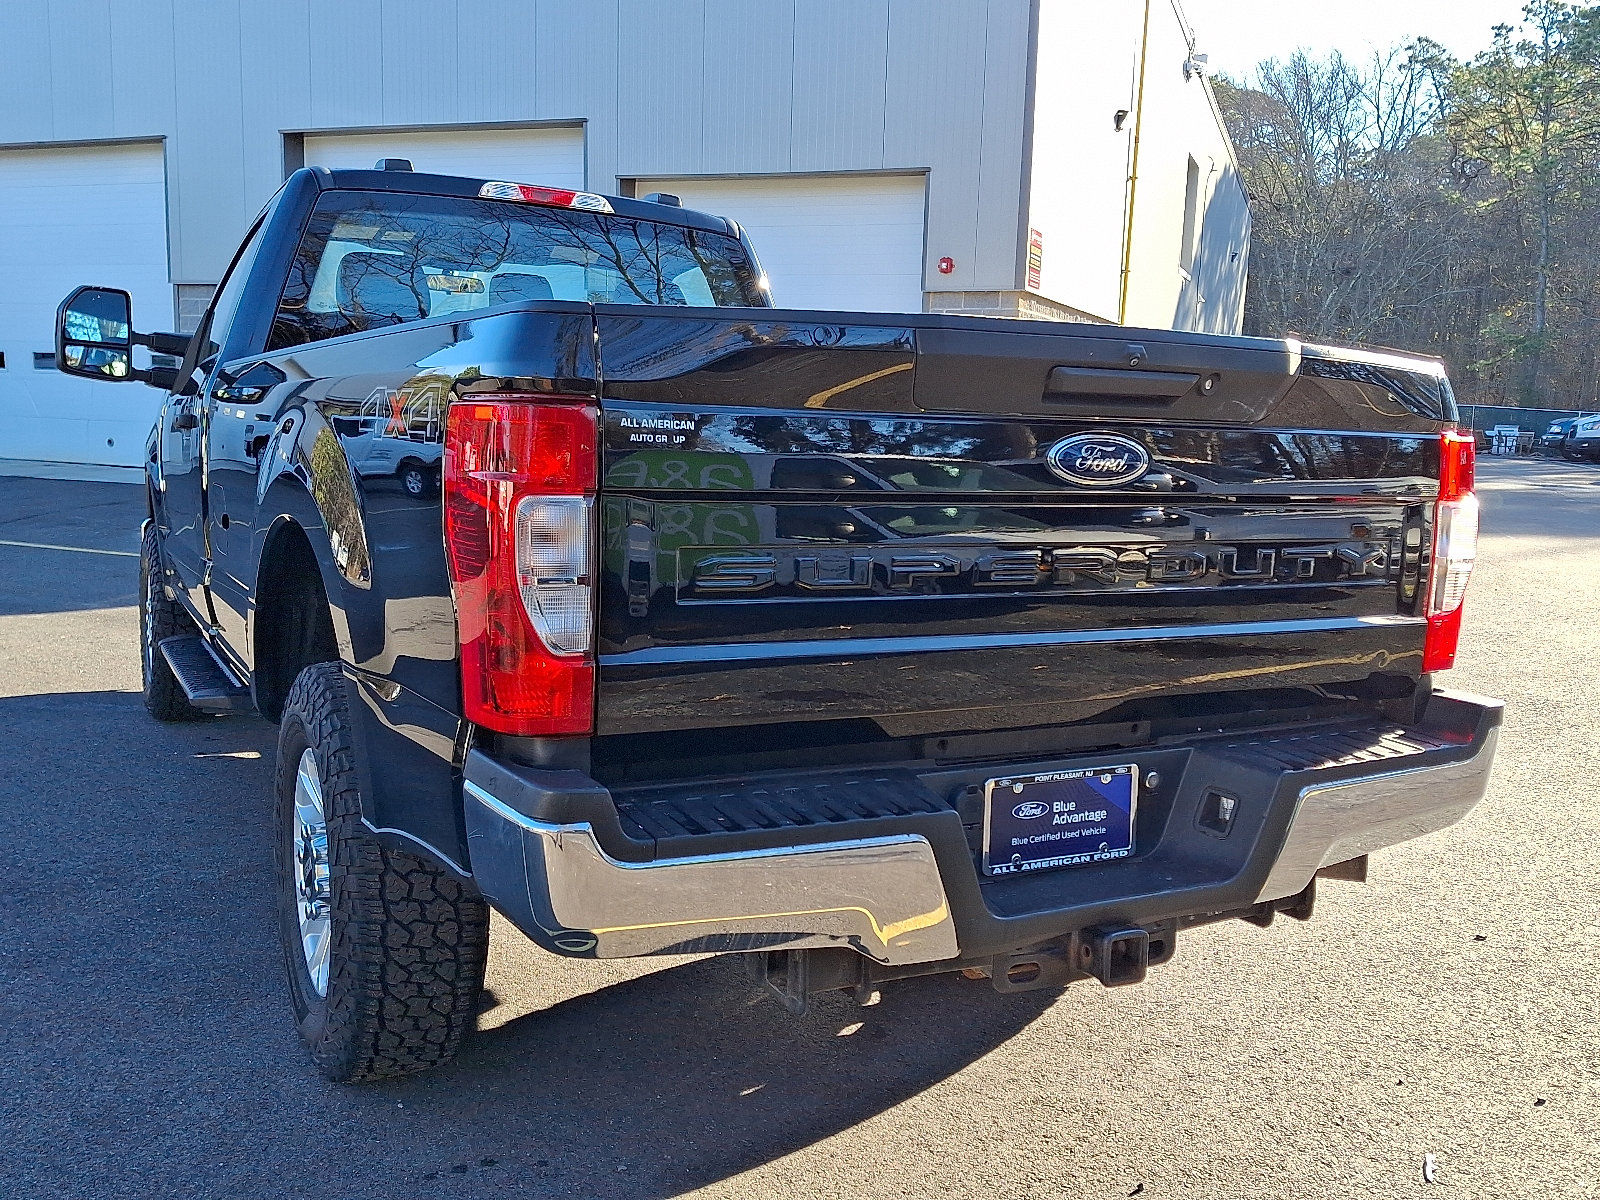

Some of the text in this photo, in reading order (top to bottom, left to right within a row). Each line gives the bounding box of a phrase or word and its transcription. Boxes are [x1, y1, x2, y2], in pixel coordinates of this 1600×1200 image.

[620, 417, 695, 430] ALL AMERICAN
[630, 433, 686, 444] AUTO GRUP
[693, 546, 1387, 593] SUPER DUTY
[1034, 775, 1053, 783] POINT
[1053, 771, 1085, 781] PLEASANT,
[1018, 804, 1043, 816] Ford
[1052, 801, 1076, 813] Blue
[1052, 810, 1107, 826] Advantage
[1011, 826, 1107, 846] Blue Certified Used Vehicle
[992, 849, 1129, 875] ALL AMERICAN FORD
